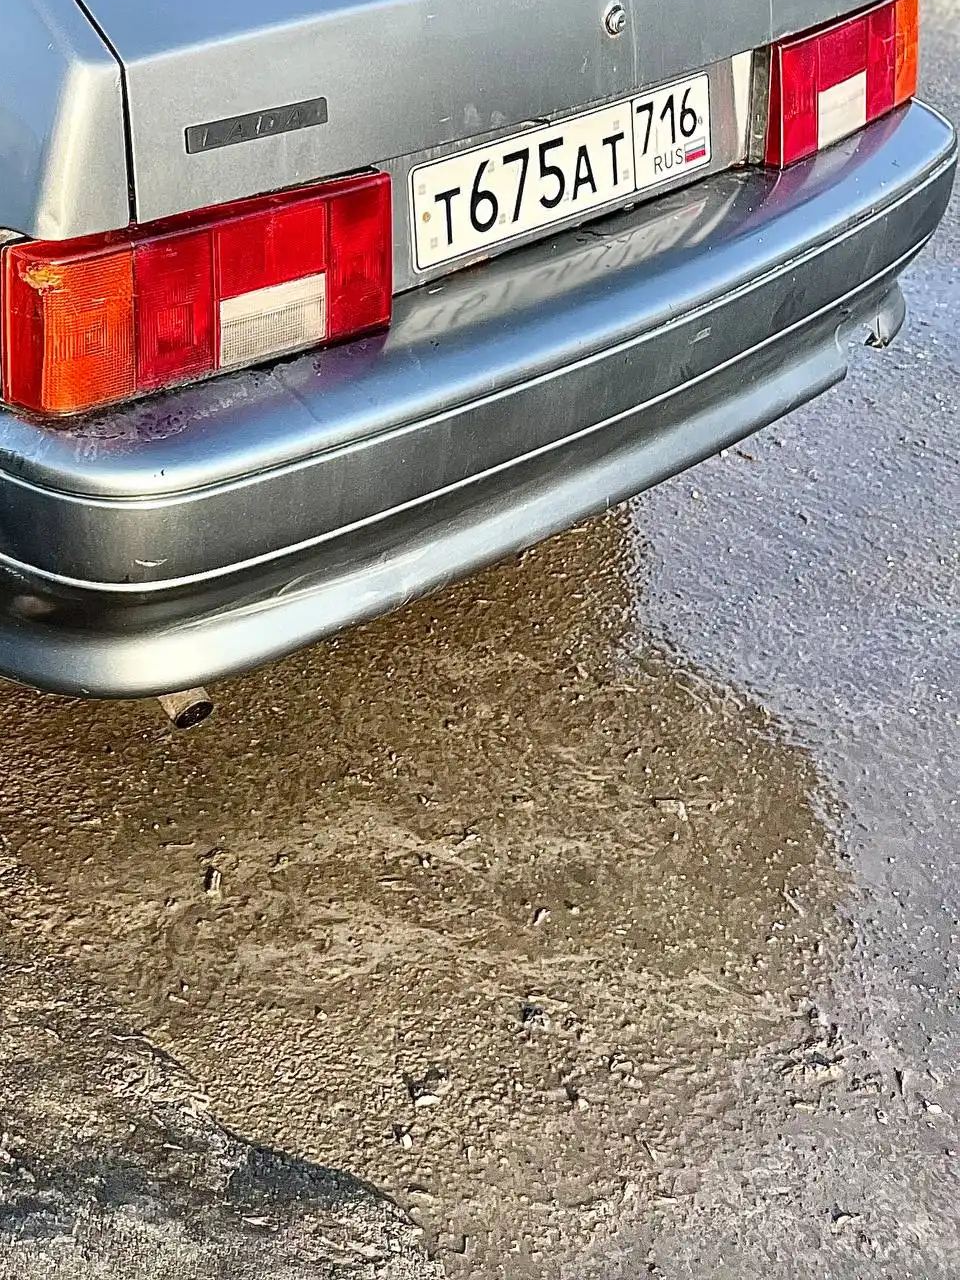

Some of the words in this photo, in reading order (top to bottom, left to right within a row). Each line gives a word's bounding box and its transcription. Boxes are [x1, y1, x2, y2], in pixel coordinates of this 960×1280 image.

[201, 108, 301, 147] LADA
[635, 87, 698, 157] 716
[653, 148, 684, 175] RUS
